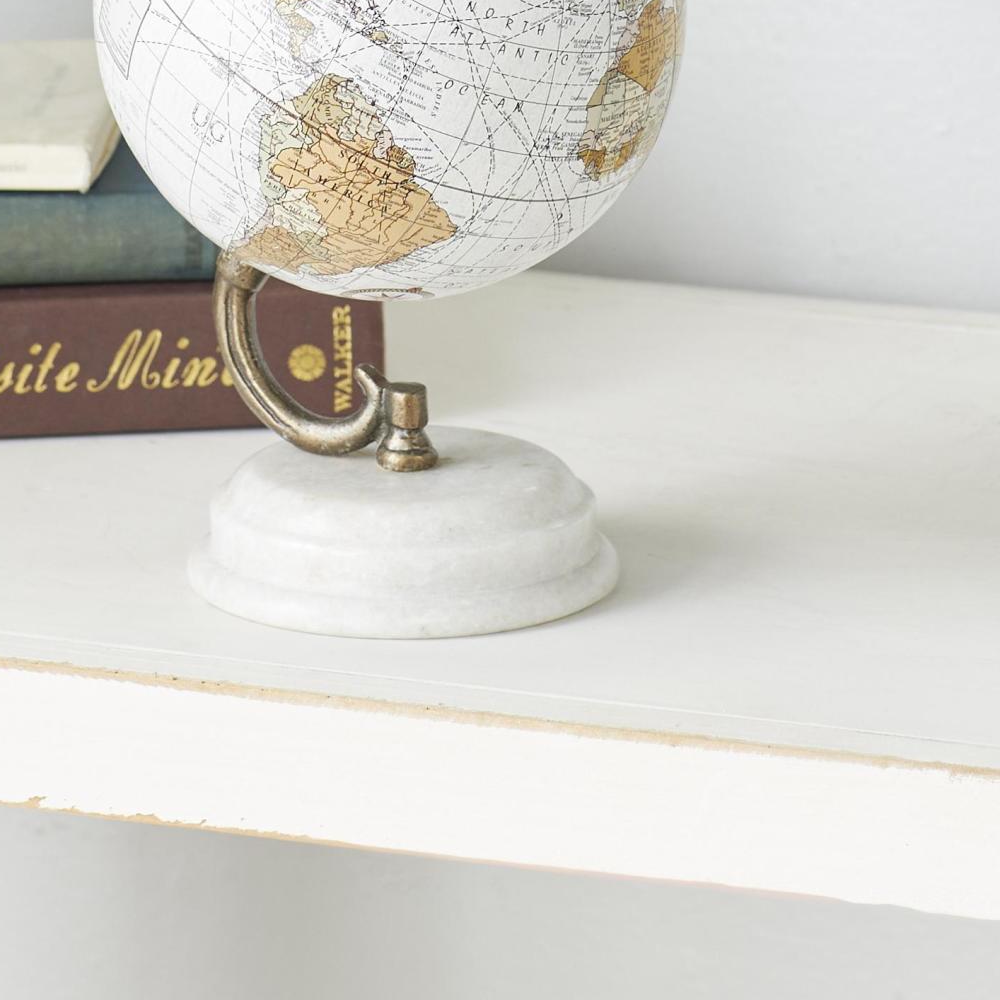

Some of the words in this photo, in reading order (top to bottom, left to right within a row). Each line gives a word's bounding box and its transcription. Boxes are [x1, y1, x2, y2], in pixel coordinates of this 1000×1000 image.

[449, 24, 569, 66] ATLANTIC
[443, 79, 524, 113] OCEAN
[86, 328, 235, 393] Min
[331, 303, 353, 413] WALKER
